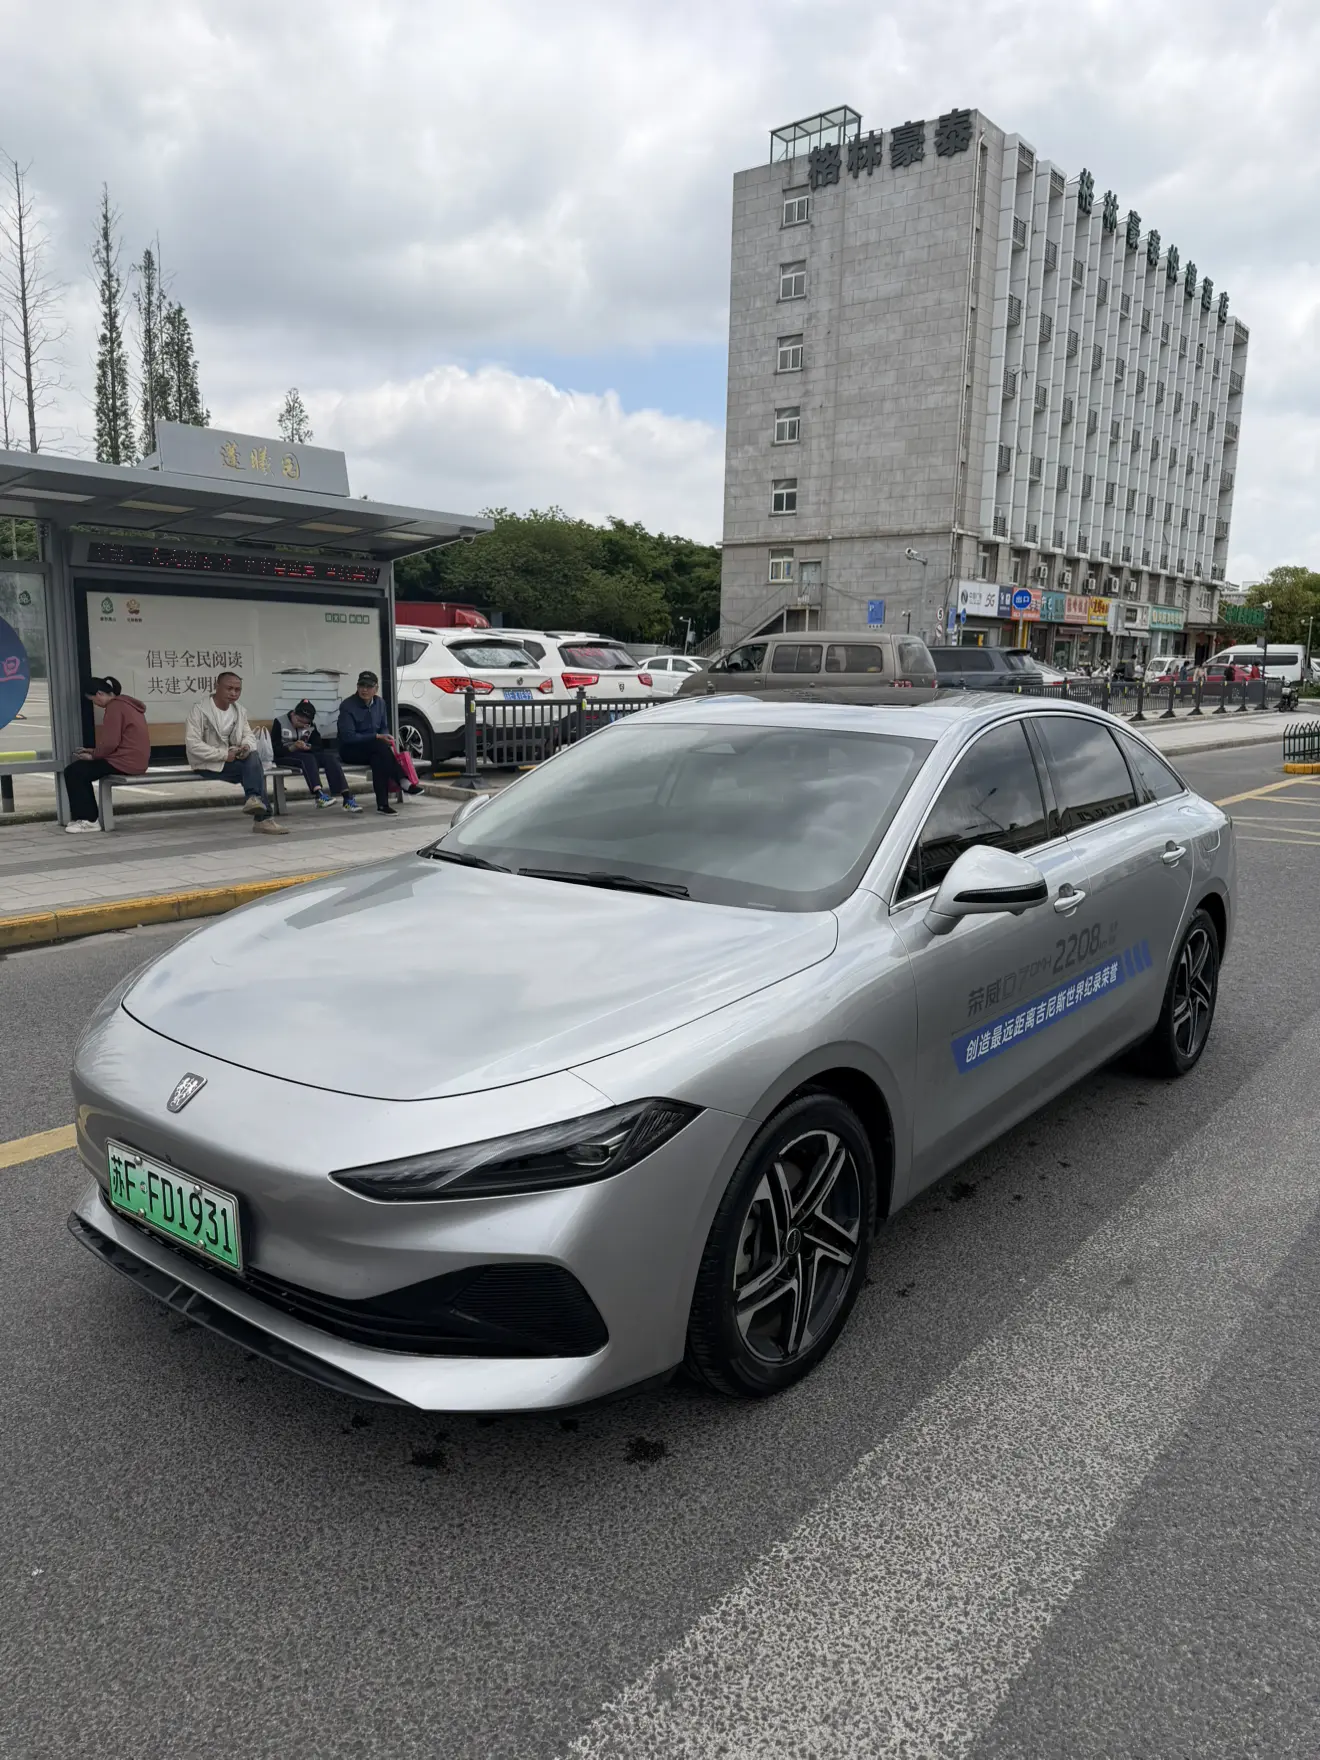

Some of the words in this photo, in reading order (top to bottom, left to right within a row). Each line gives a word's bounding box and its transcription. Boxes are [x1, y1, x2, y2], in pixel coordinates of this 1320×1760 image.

[808, 108, 974, 191] 格林豪泰
[1015, 595, 1030, 604] 出口
[146, 649, 243, 669] 倡导全民阅读
[148, 676, 217, 695] 共建文明
[965, 961, 1118, 1064] 创造最远距离吉尼斯世界纪录荣誉
